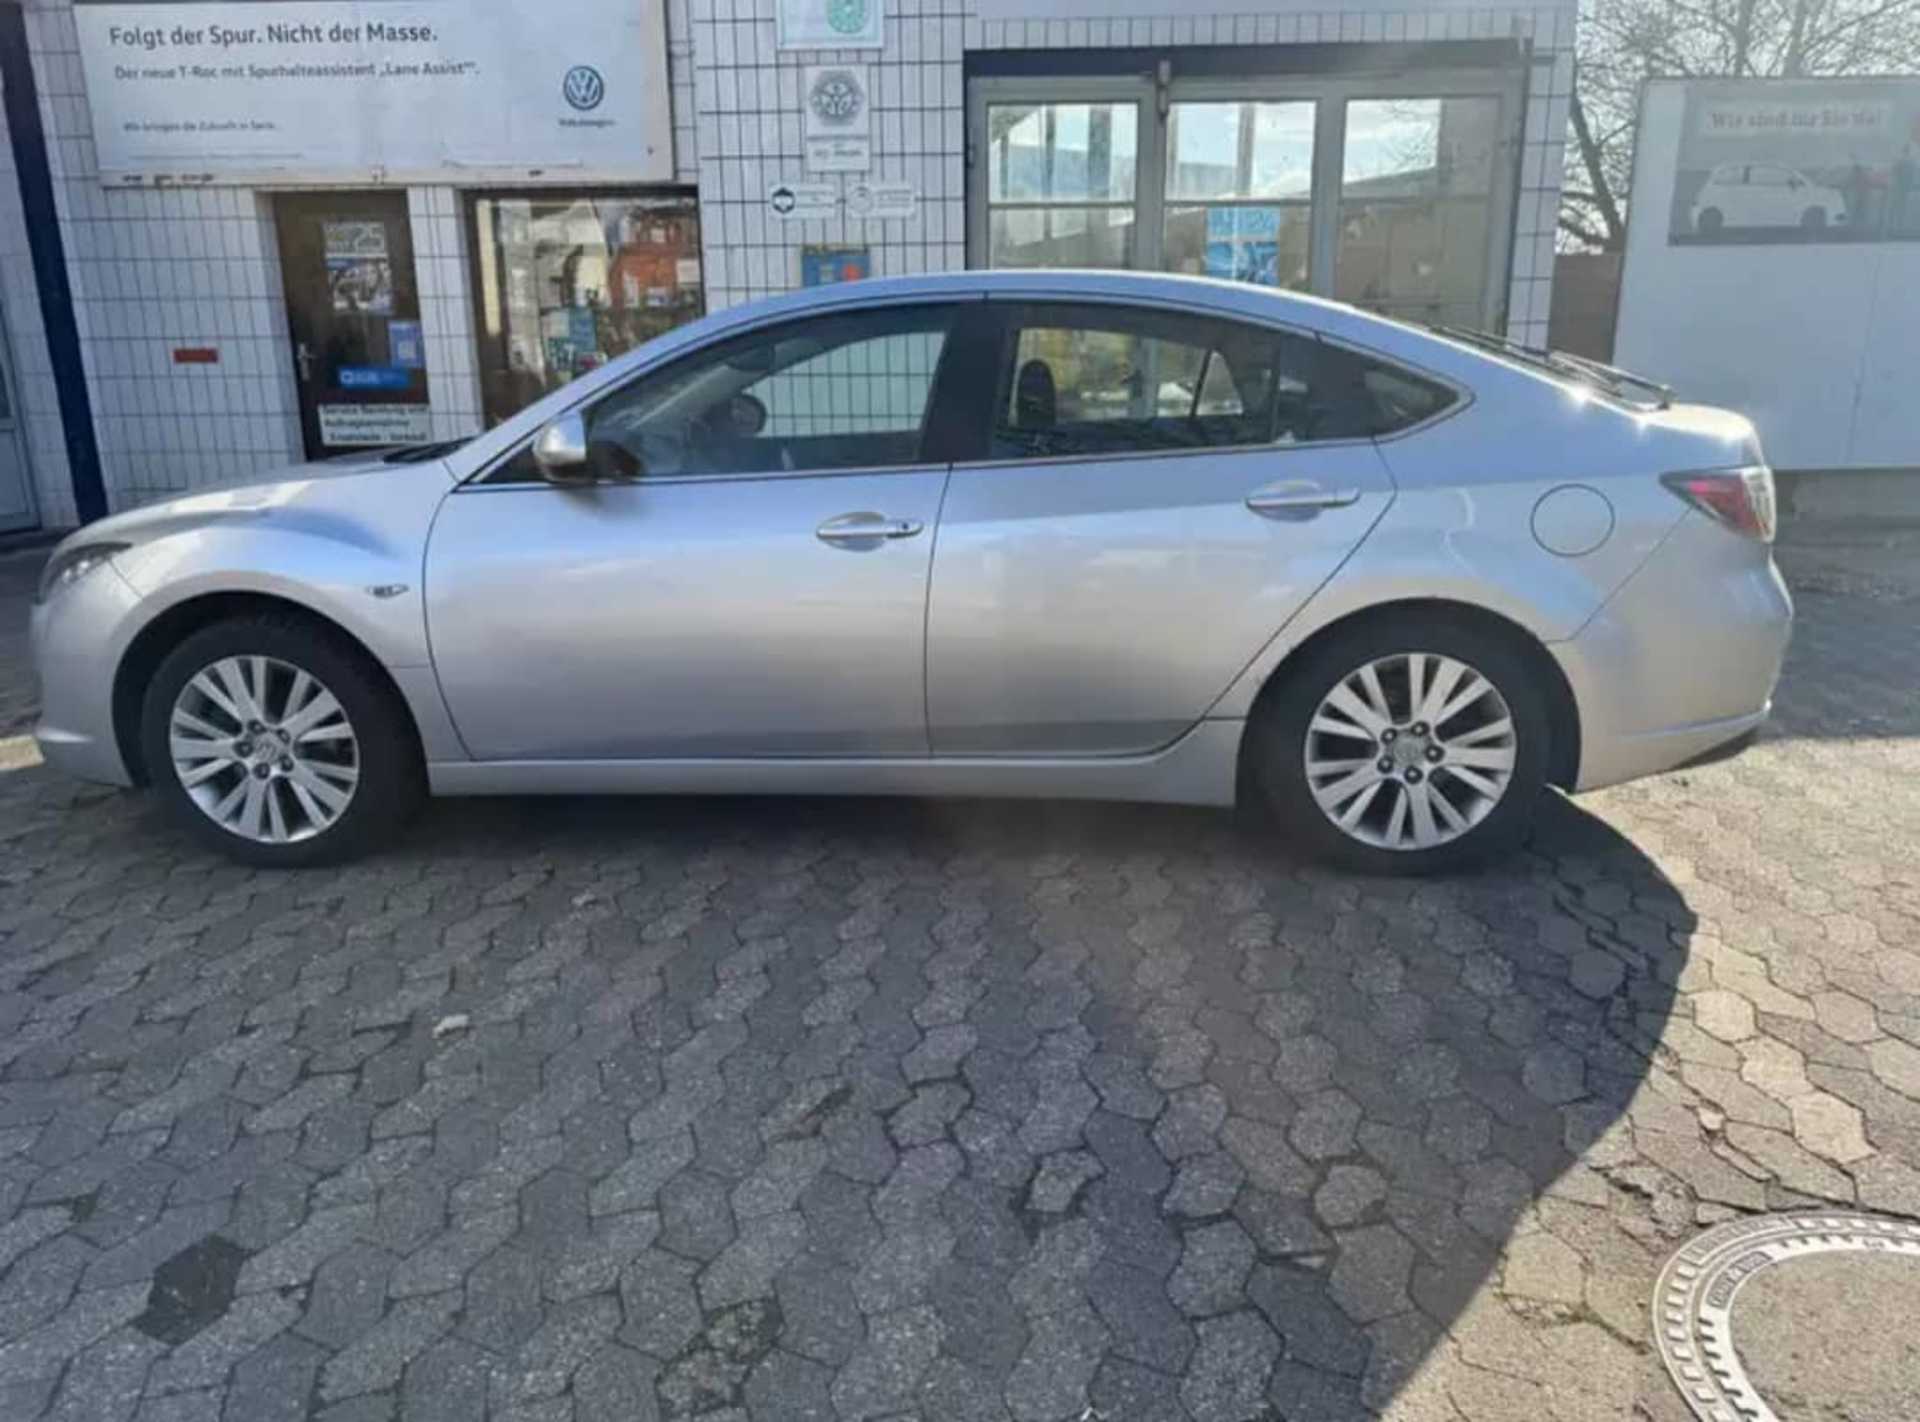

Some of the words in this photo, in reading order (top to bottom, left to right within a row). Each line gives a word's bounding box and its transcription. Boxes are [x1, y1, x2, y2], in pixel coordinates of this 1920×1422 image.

[109, 26, 166, 50] Folgt
[171, 25, 203, 45] der
[209, 24, 262, 48] Spur.
[267, 23, 323, 43] Nicht
[329, 21, 360, 42] der
[366, 21, 438, 42] Masse.
[114, 65, 139, 79] Der
[142, 68, 176, 78] neue
[179, 65, 217, 78] T-Roc
[221, 65, 245, 77] mit
